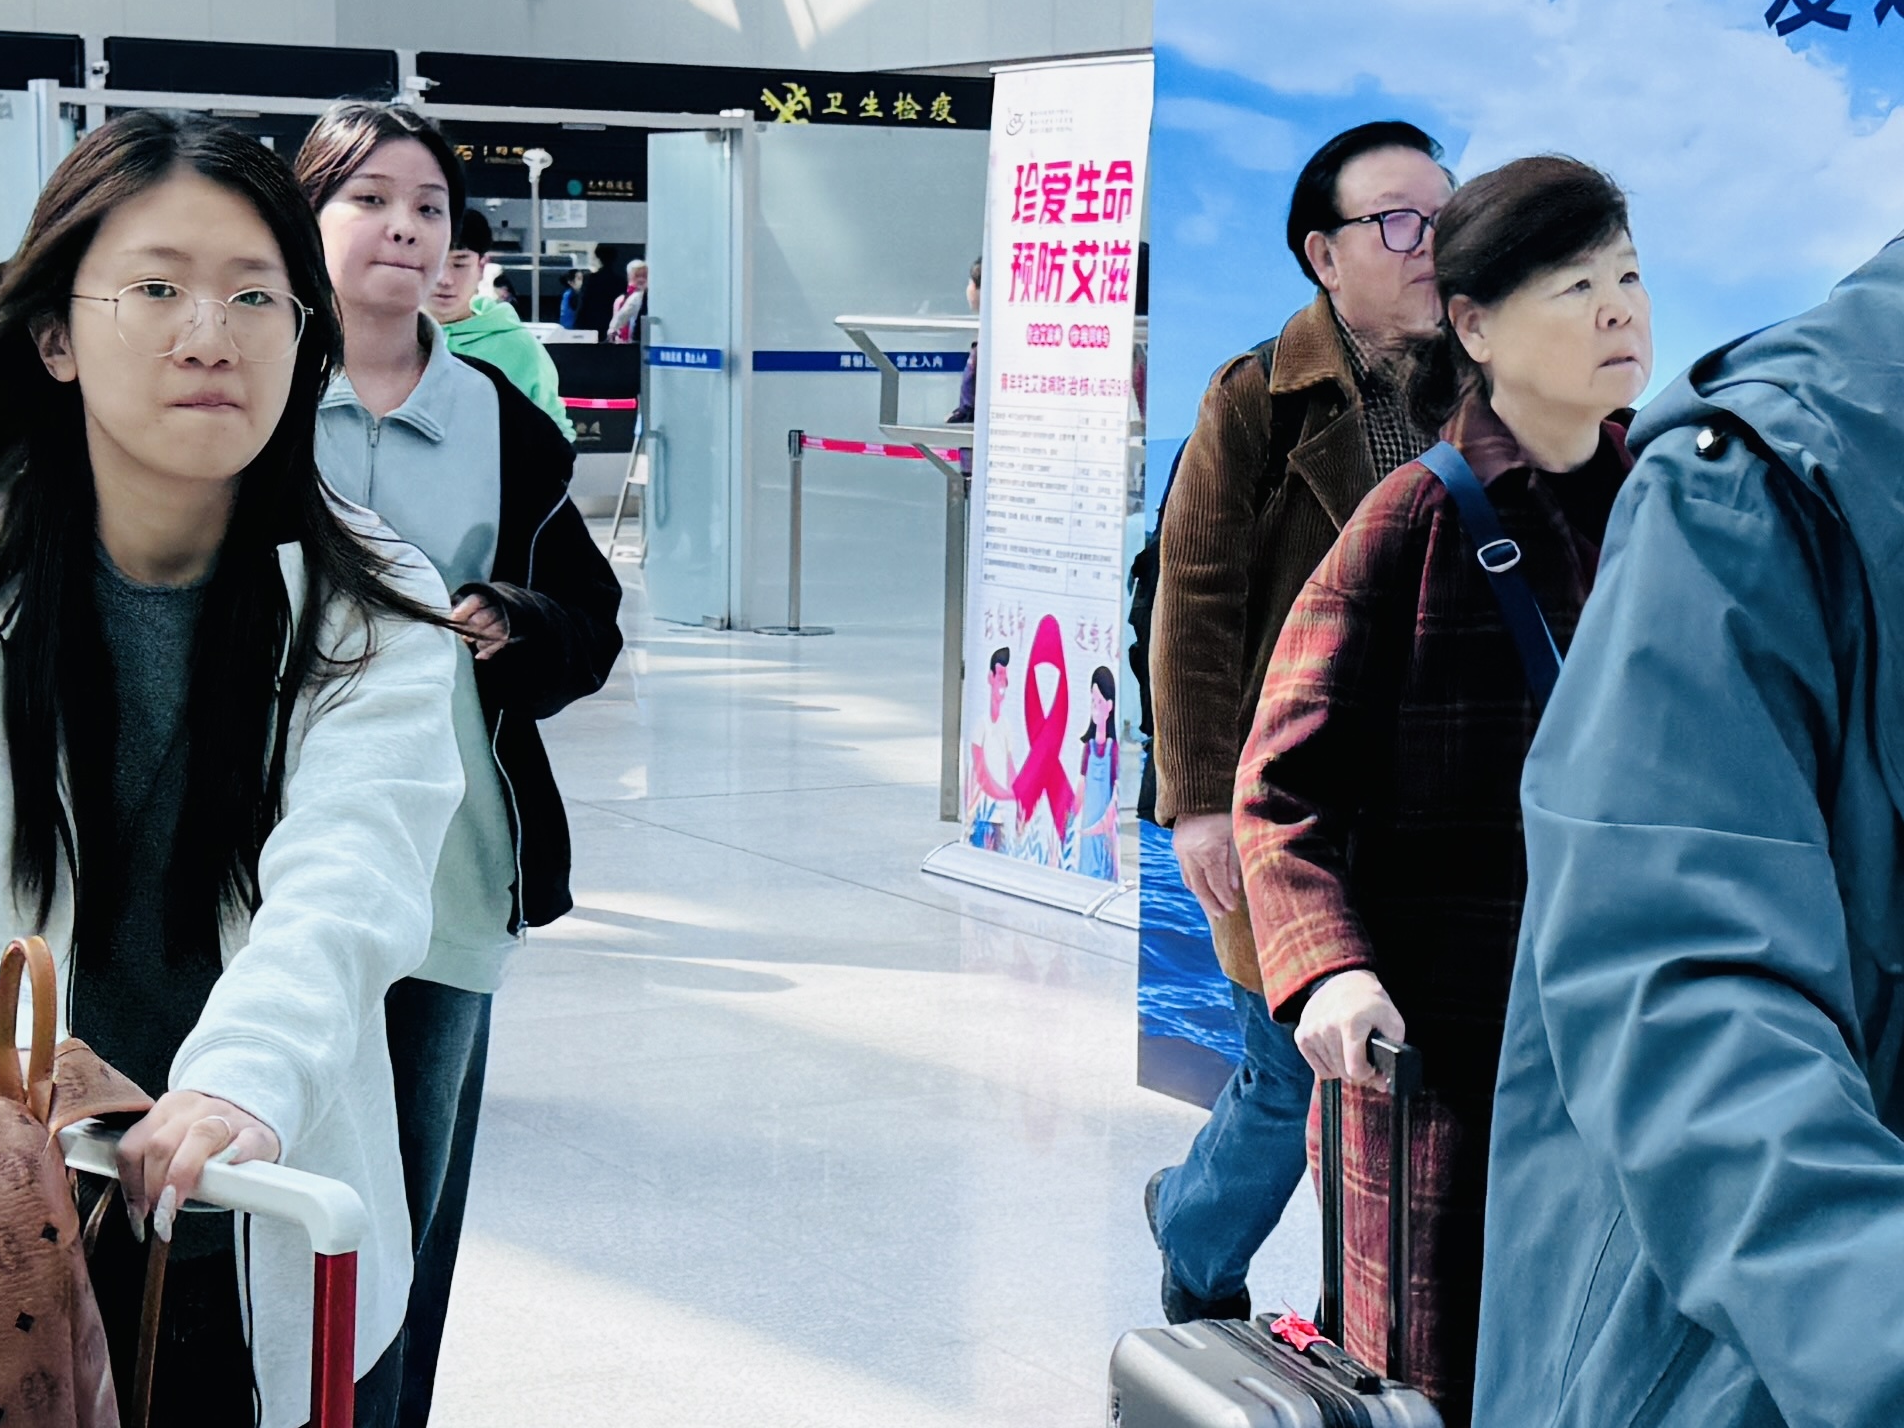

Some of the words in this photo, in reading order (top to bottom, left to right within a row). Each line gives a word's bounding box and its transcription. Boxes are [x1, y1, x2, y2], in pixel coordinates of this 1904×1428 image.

[821, 90, 957, 124] 卫生检疫
[1011, 159, 1135, 225] 珍爱生命
[1008, 239, 1132, 305] 预防艾滋
[840, 354, 886, 368] 限制区
